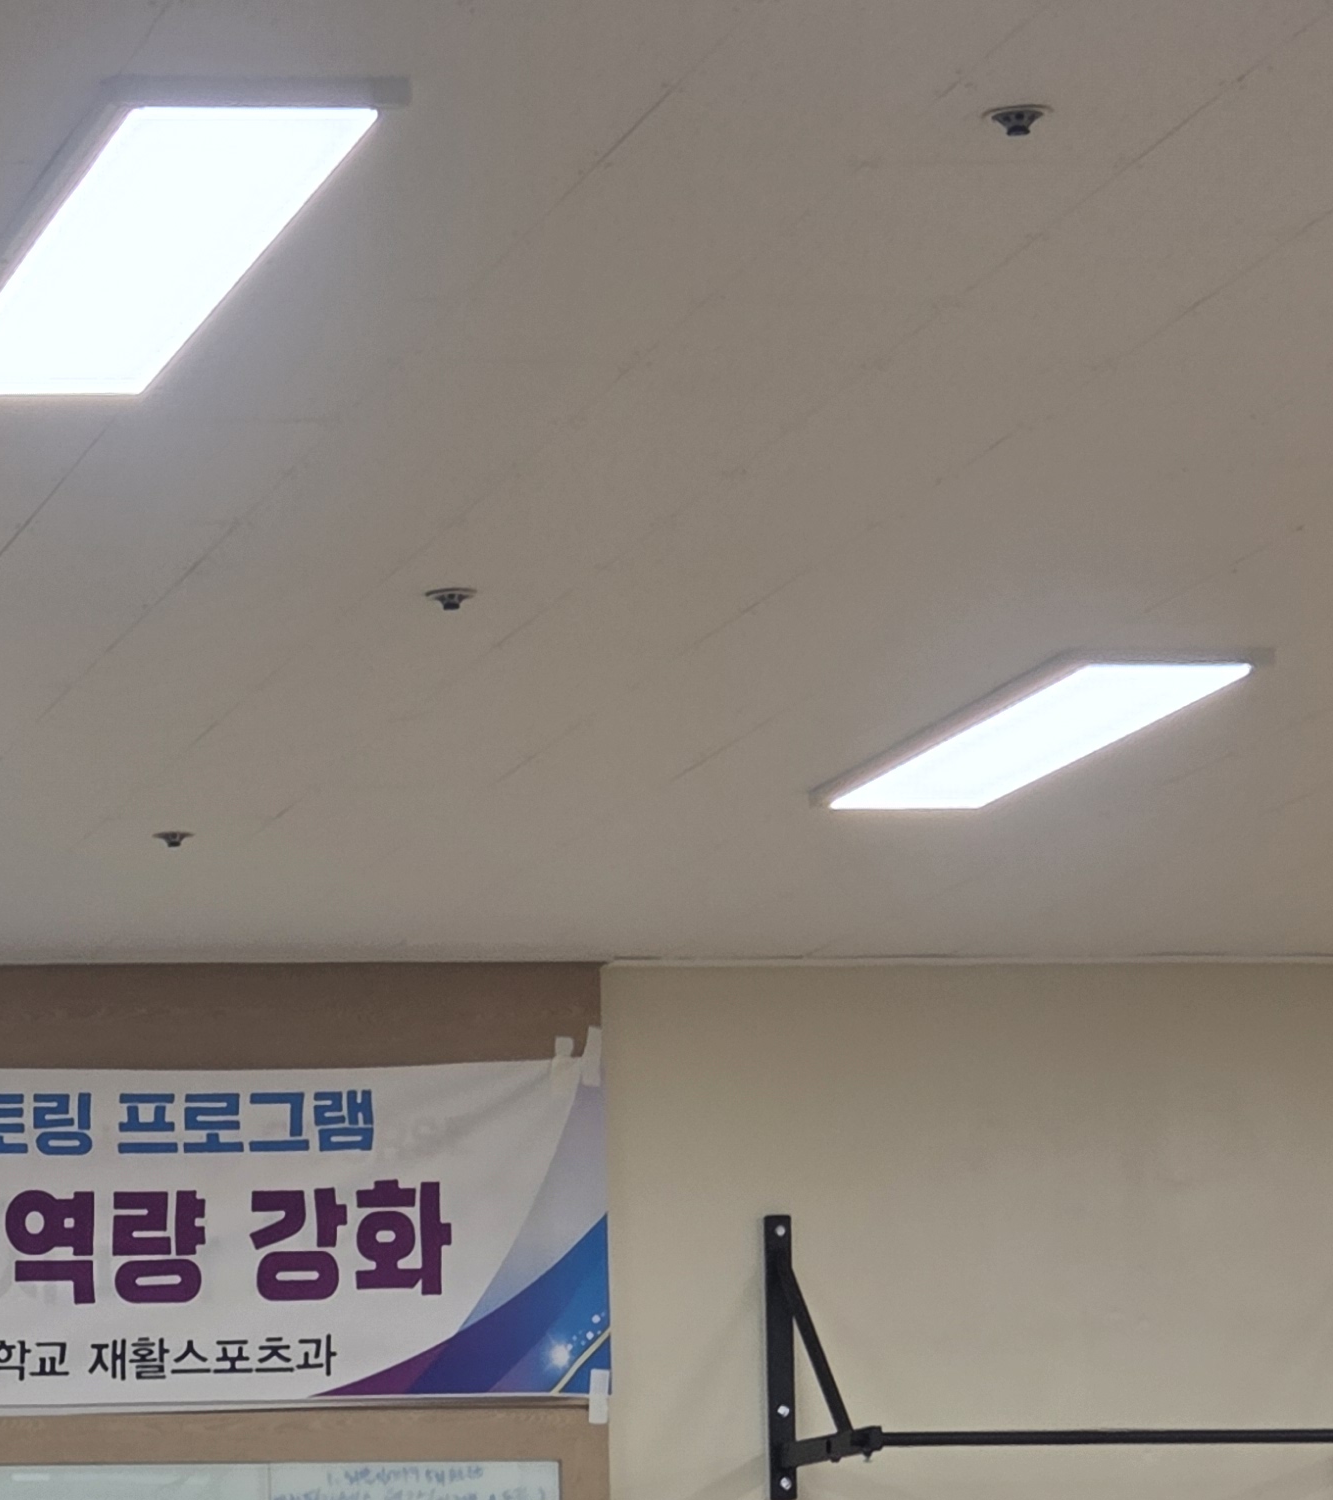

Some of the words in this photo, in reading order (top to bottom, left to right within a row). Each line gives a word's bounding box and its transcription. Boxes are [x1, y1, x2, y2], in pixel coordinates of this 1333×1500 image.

[117, 1089, 375, 1155] 프로그램
[4, 1189, 206, 1305] 역량
[249, 1178, 452, 1302] 강화
[88, 1334, 338, 1382] 재활스포츠과
